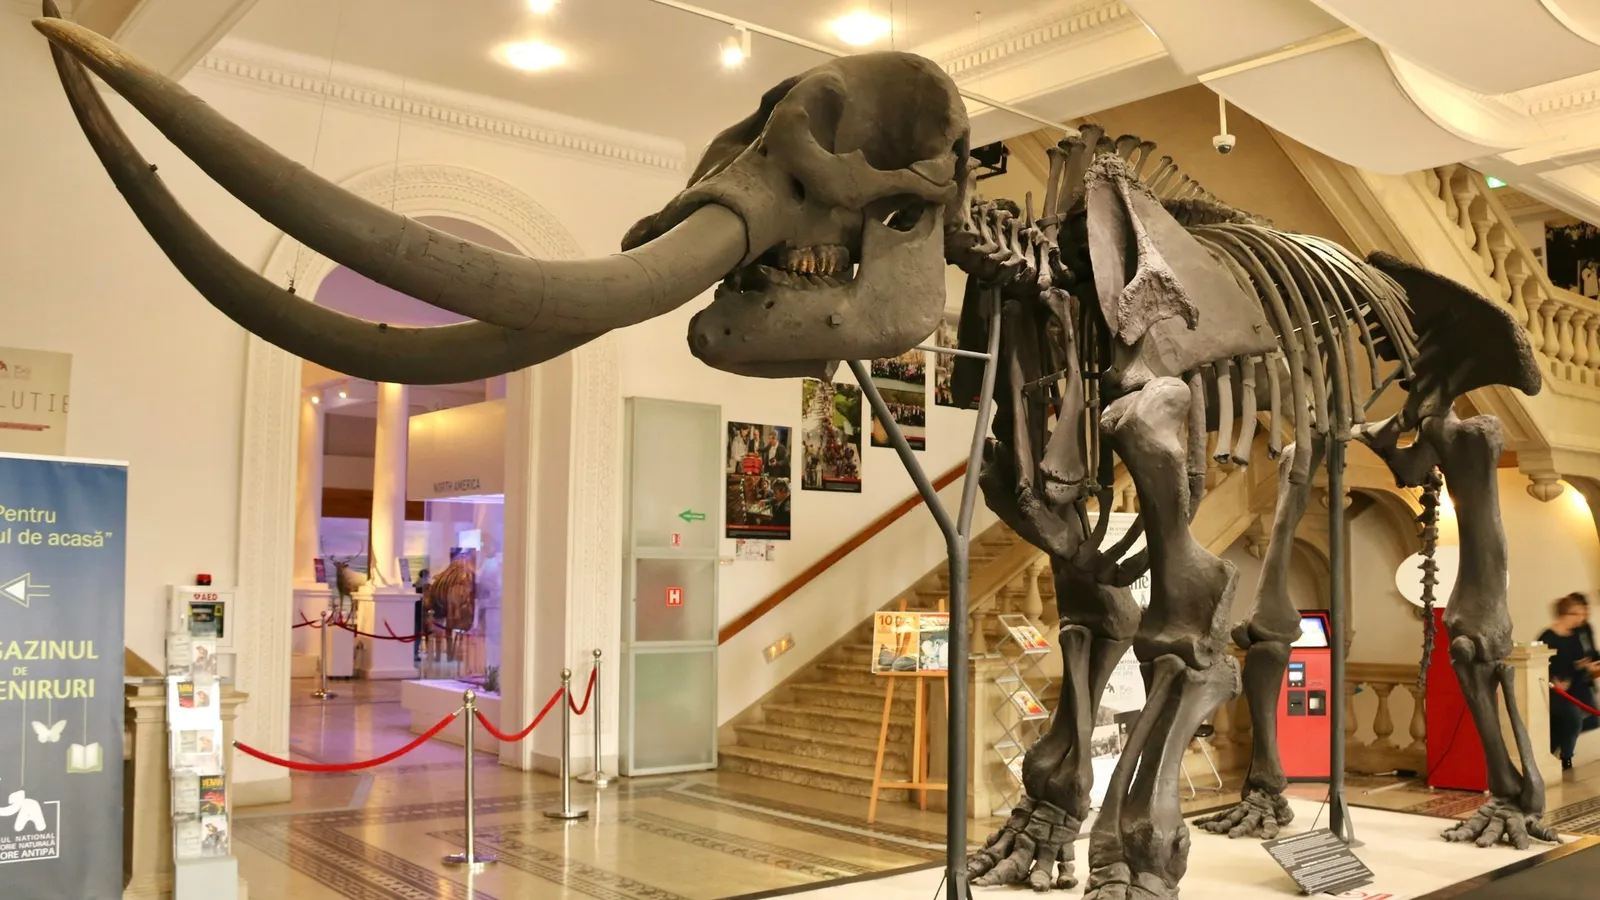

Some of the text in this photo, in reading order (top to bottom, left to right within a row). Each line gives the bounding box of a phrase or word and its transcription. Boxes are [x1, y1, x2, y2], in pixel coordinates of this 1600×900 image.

[0, 390, 69, 414] UTIE
[433, 478, 481, 493] NORTH AMERICA
[18, 528, 43, 545] de
[201, 593, 218, 601] AED
[669, 589, 680, 604] H
[879, 615, 893, 626] 10
[0, 640, 99, 661] AZINUL
[12, 666, 29, 676] DE
[20, 847, 56, 857] ANTIPA
